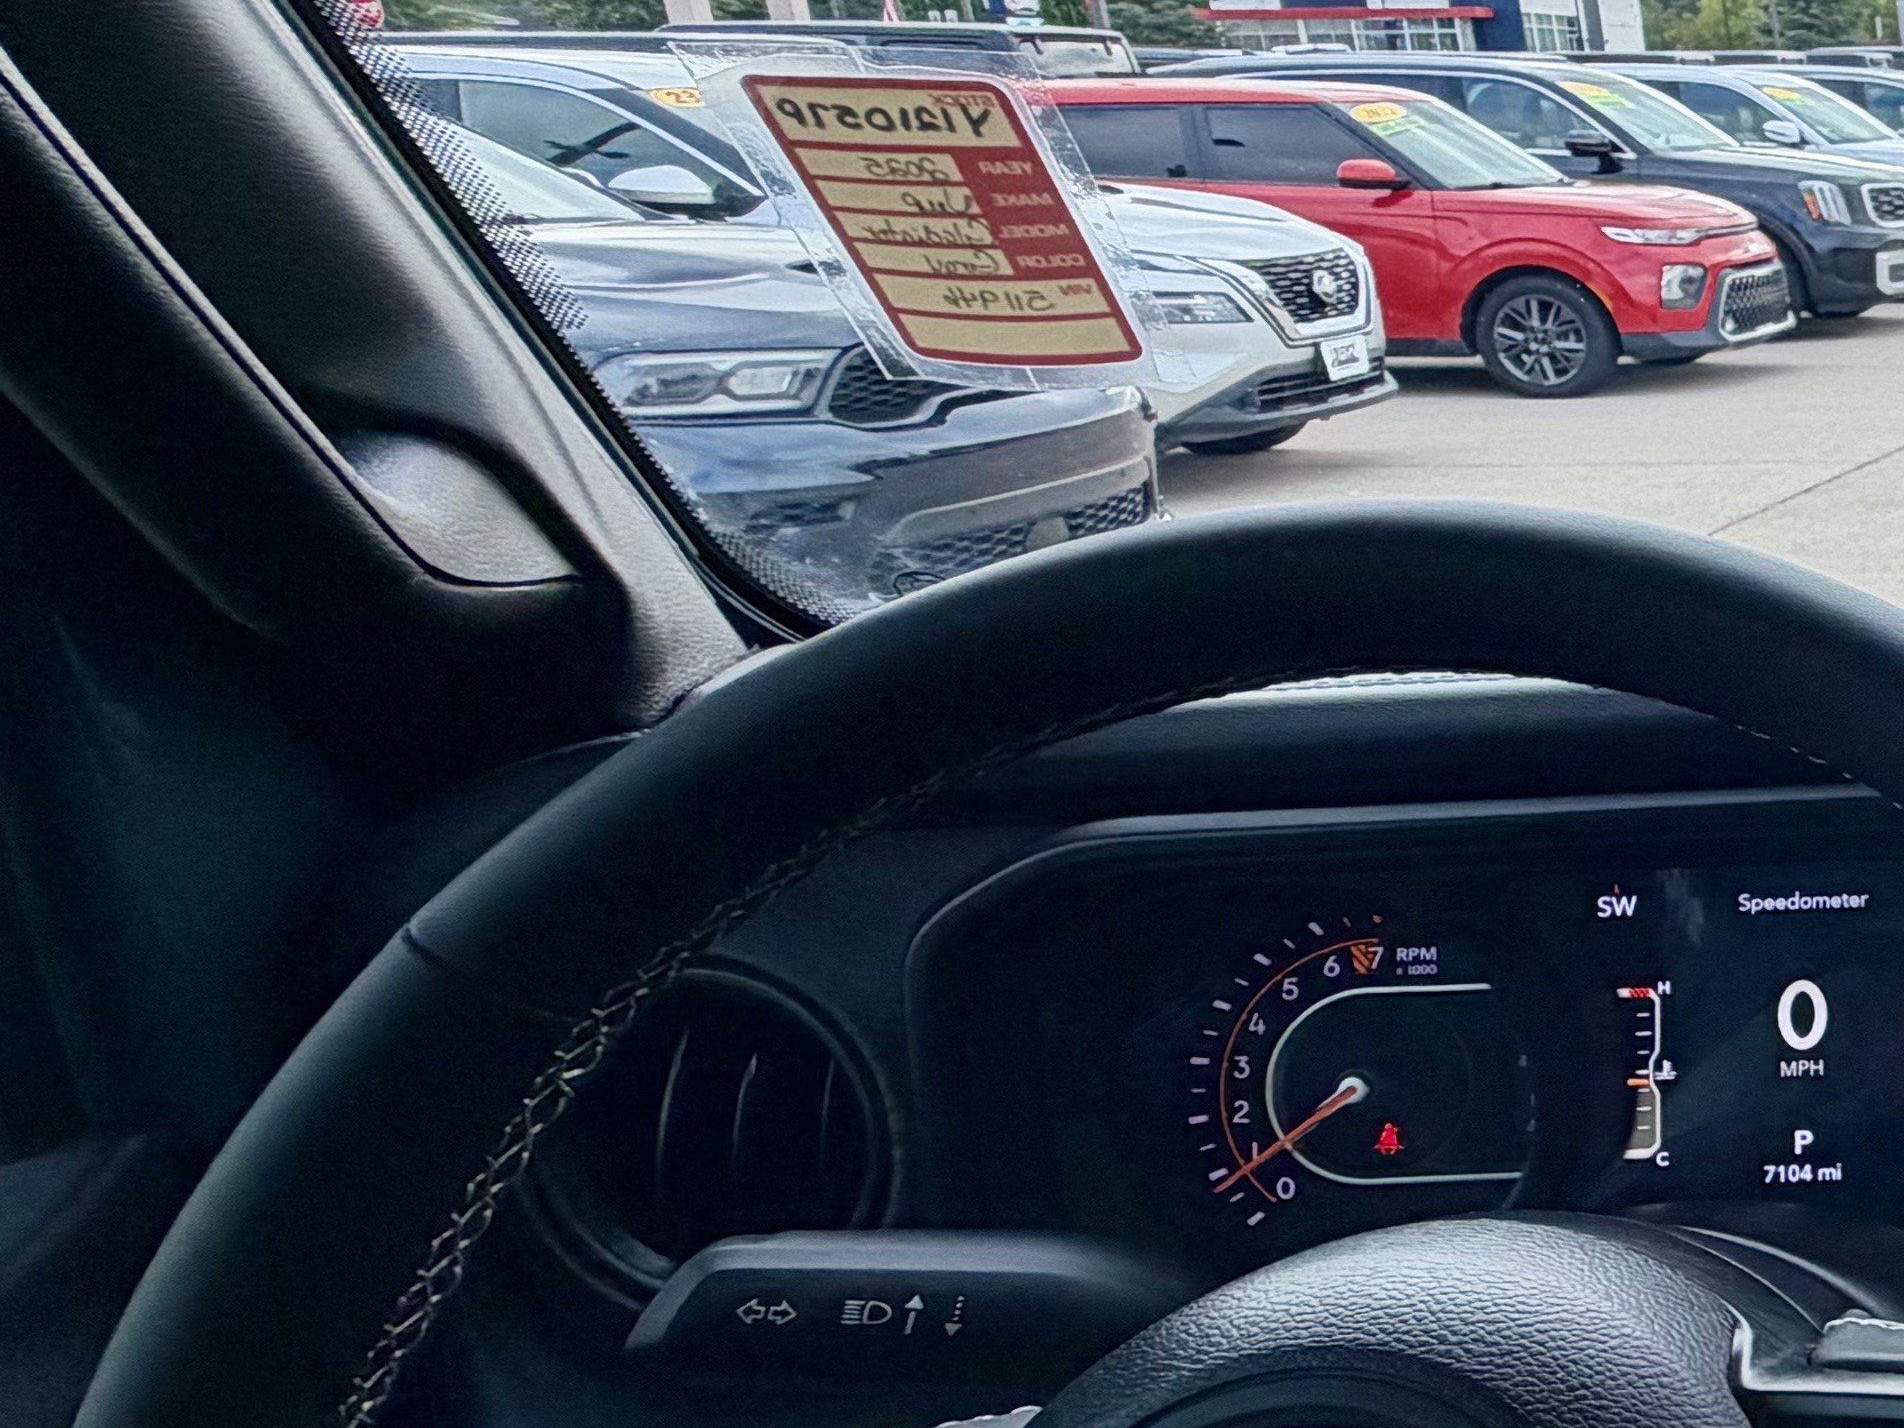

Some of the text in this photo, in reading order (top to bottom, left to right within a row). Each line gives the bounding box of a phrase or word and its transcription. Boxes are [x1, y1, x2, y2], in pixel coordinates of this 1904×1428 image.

[1596, 895, 1638, 918] SW
[1737, 890, 1870, 915] Speedometer
[1366, 945, 1384, 970] 7
[1395, 945, 1438, 963] RPM
[1322, 955, 1341, 978] 6
[1281, 976, 1300, 1002] 5
[1657, 980, 1672, 996] H
[1248, 1012, 1267, 1036] 4
[1776, 978, 1829, 1051] 0
[1232, 1055, 1251, 1079] 3
[1779, 1059, 1826, 1078] MPH
[1232, 1100, 1251, 1125] 2
[1793, 1129, 1815, 1155] P
[1655, 1151, 1671, 1167] C
[1762, 1162, 1843, 1184] 7104 mi
[1275, 1176, 1297, 1200] 0
